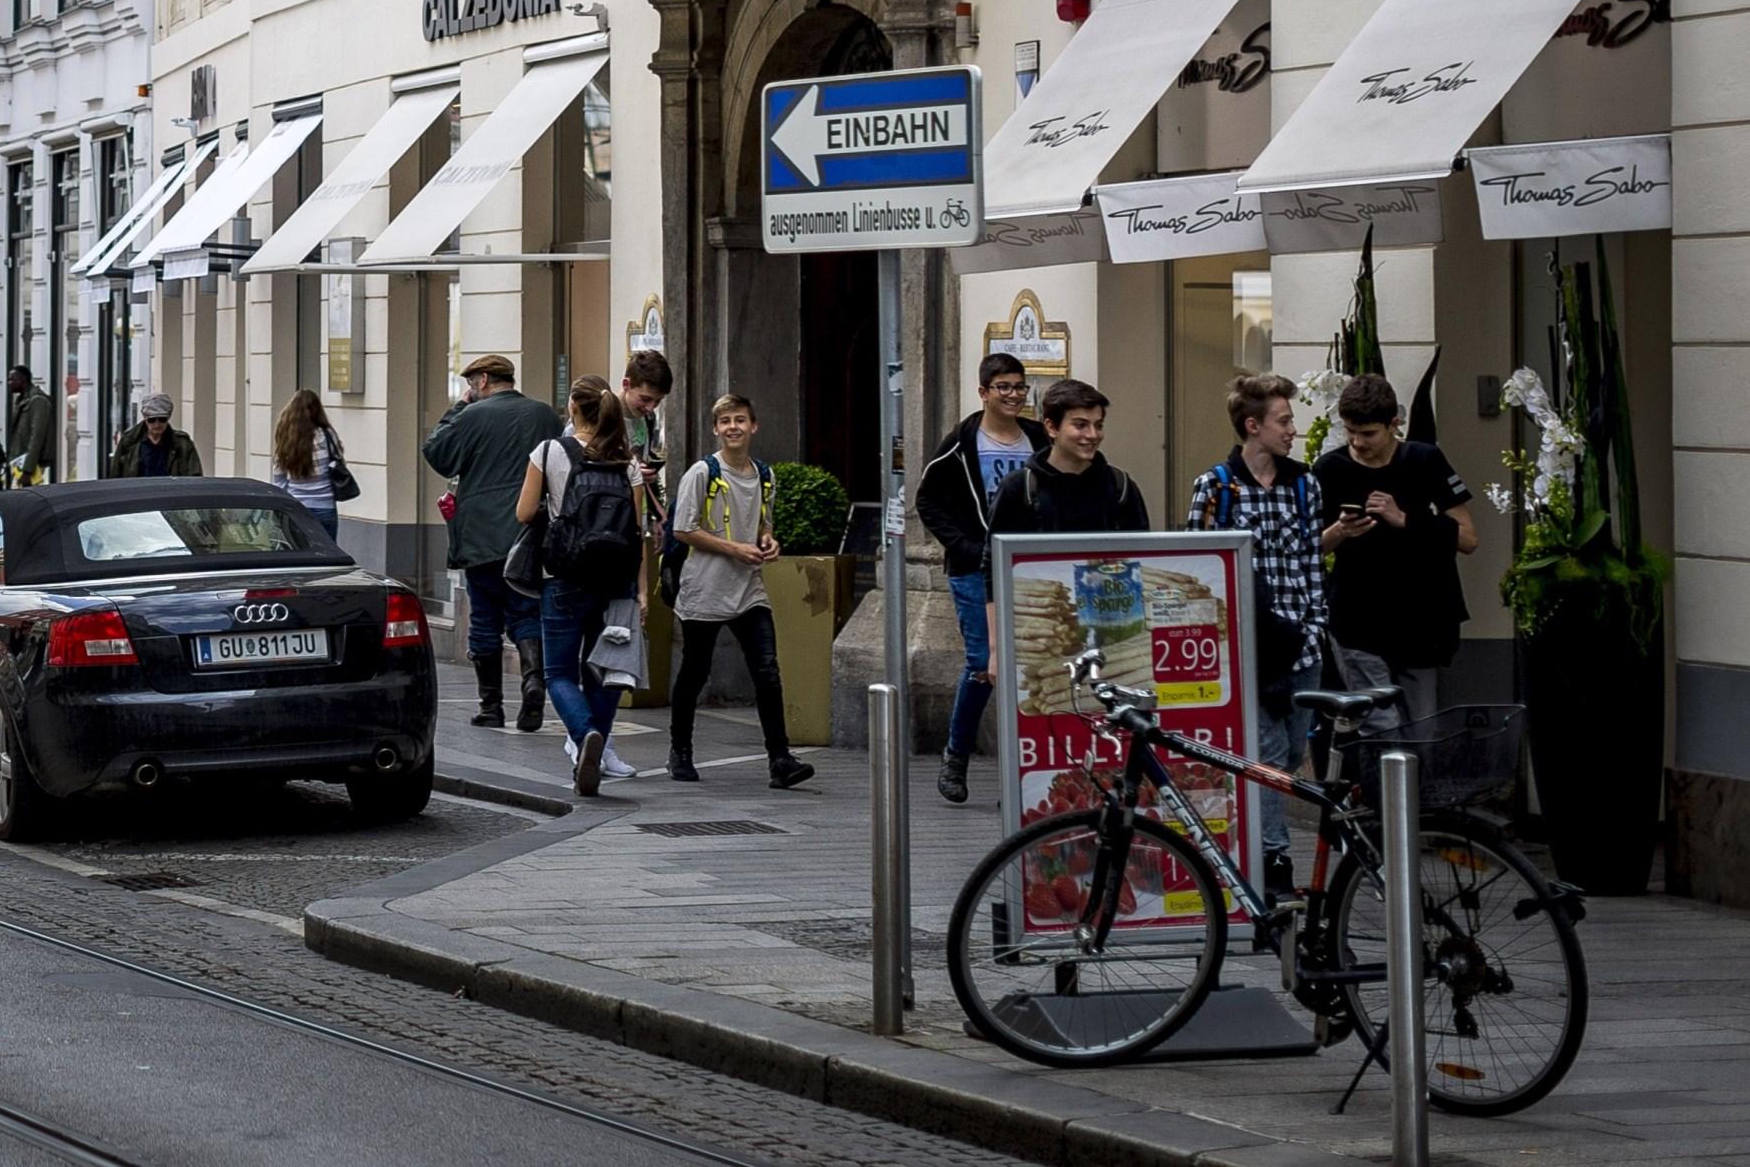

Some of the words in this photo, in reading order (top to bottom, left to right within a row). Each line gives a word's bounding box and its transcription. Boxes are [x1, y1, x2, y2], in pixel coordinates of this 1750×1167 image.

[826, 109, 949, 149] EINBAHN
[1479, 171, 1576, 207] Thomas
[1572, 163, 1670, 207] Sabo
[770, 211, 848, 243] ausgenommen
[852, 200, 920, 233] Linienbusse
[925, 209, 936, 230] u.
[1108, 205, 1188, 234] Thomas
[1185, 196, 1263, 234] Sabo
[219, 637, 243, 658] GU
[1154, 637, 1217, 672] 2.99
[1158, 785, 1262, 917] GENESIS
